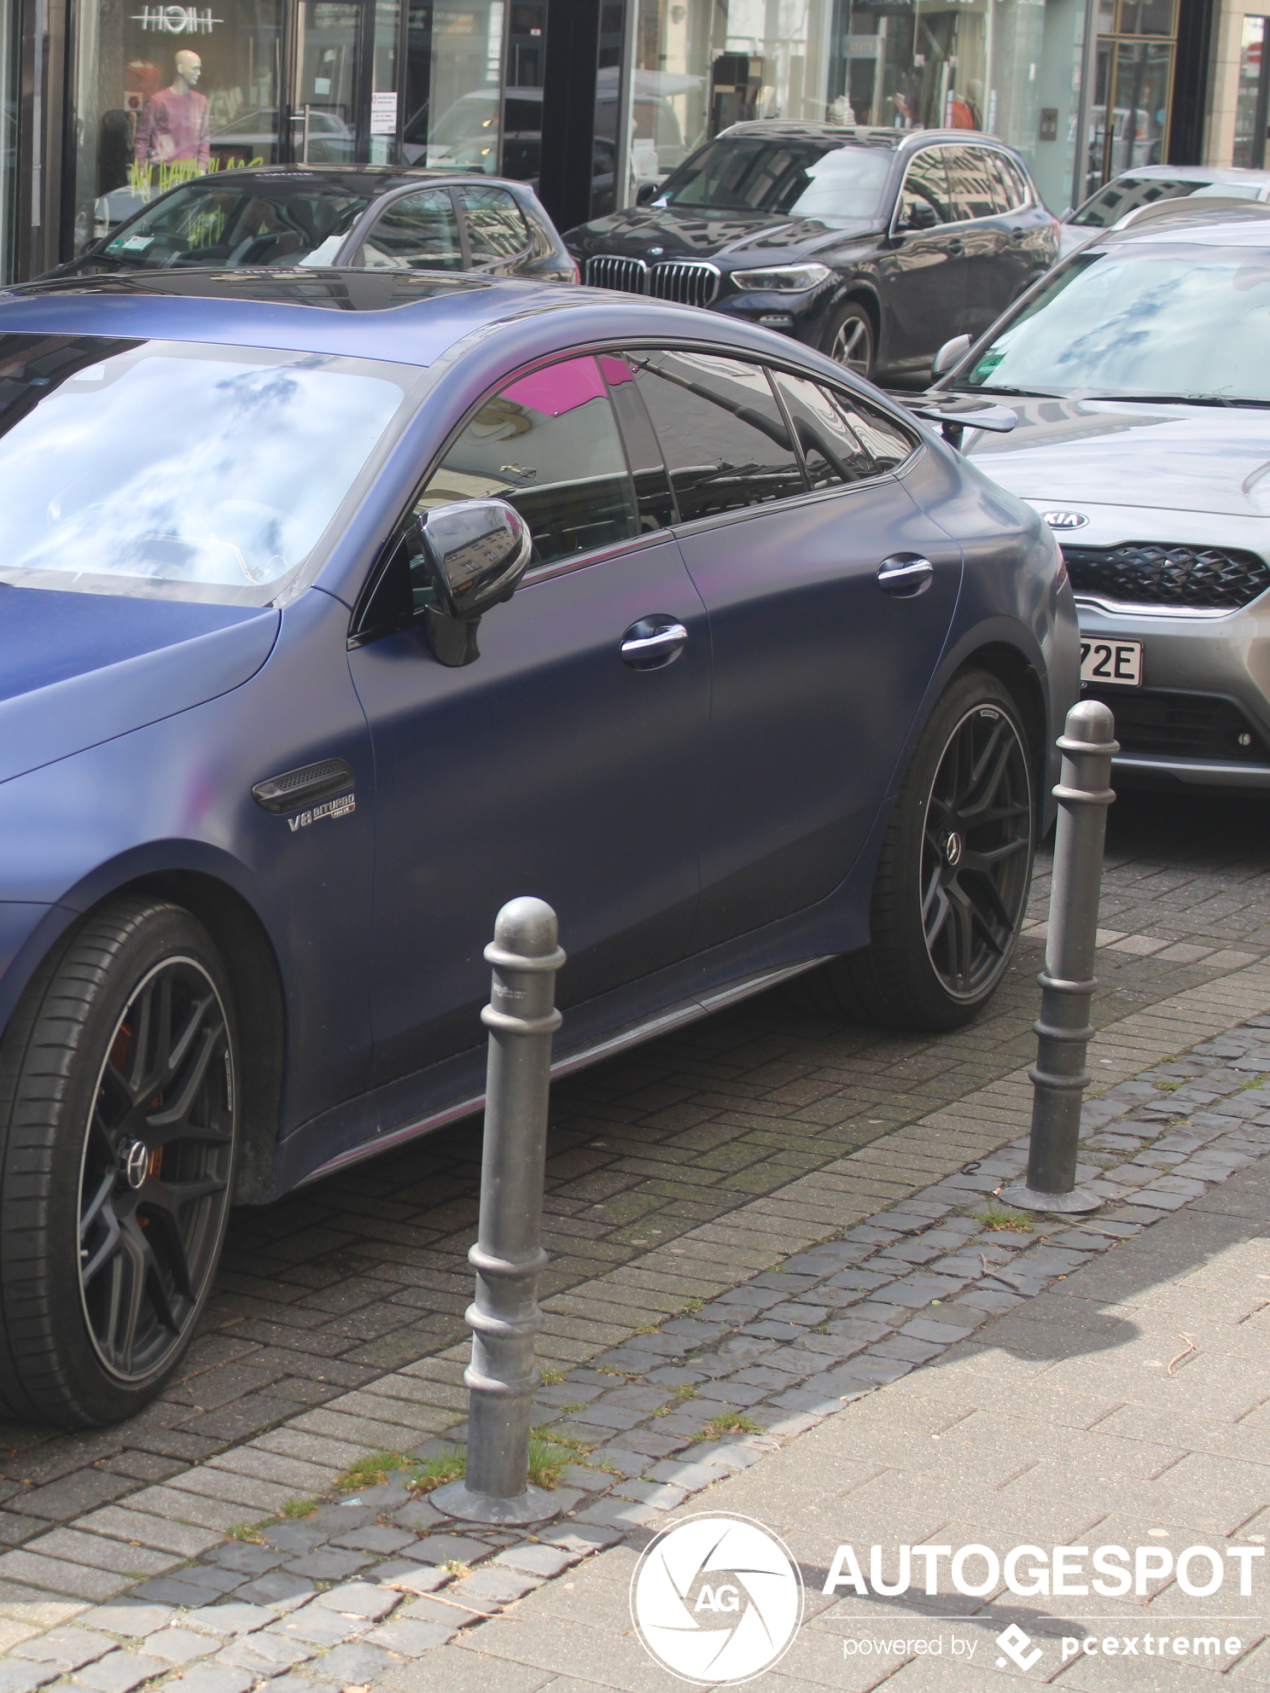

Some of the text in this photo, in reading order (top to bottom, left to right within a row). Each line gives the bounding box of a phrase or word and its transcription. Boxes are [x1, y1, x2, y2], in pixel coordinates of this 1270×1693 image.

[1044, 513, 1078, 526] KIA
[1081, 644, 1135, 680] 72E
[288, 810, 313, 832] V8
[313, 793, 356, 818] BITURBO
